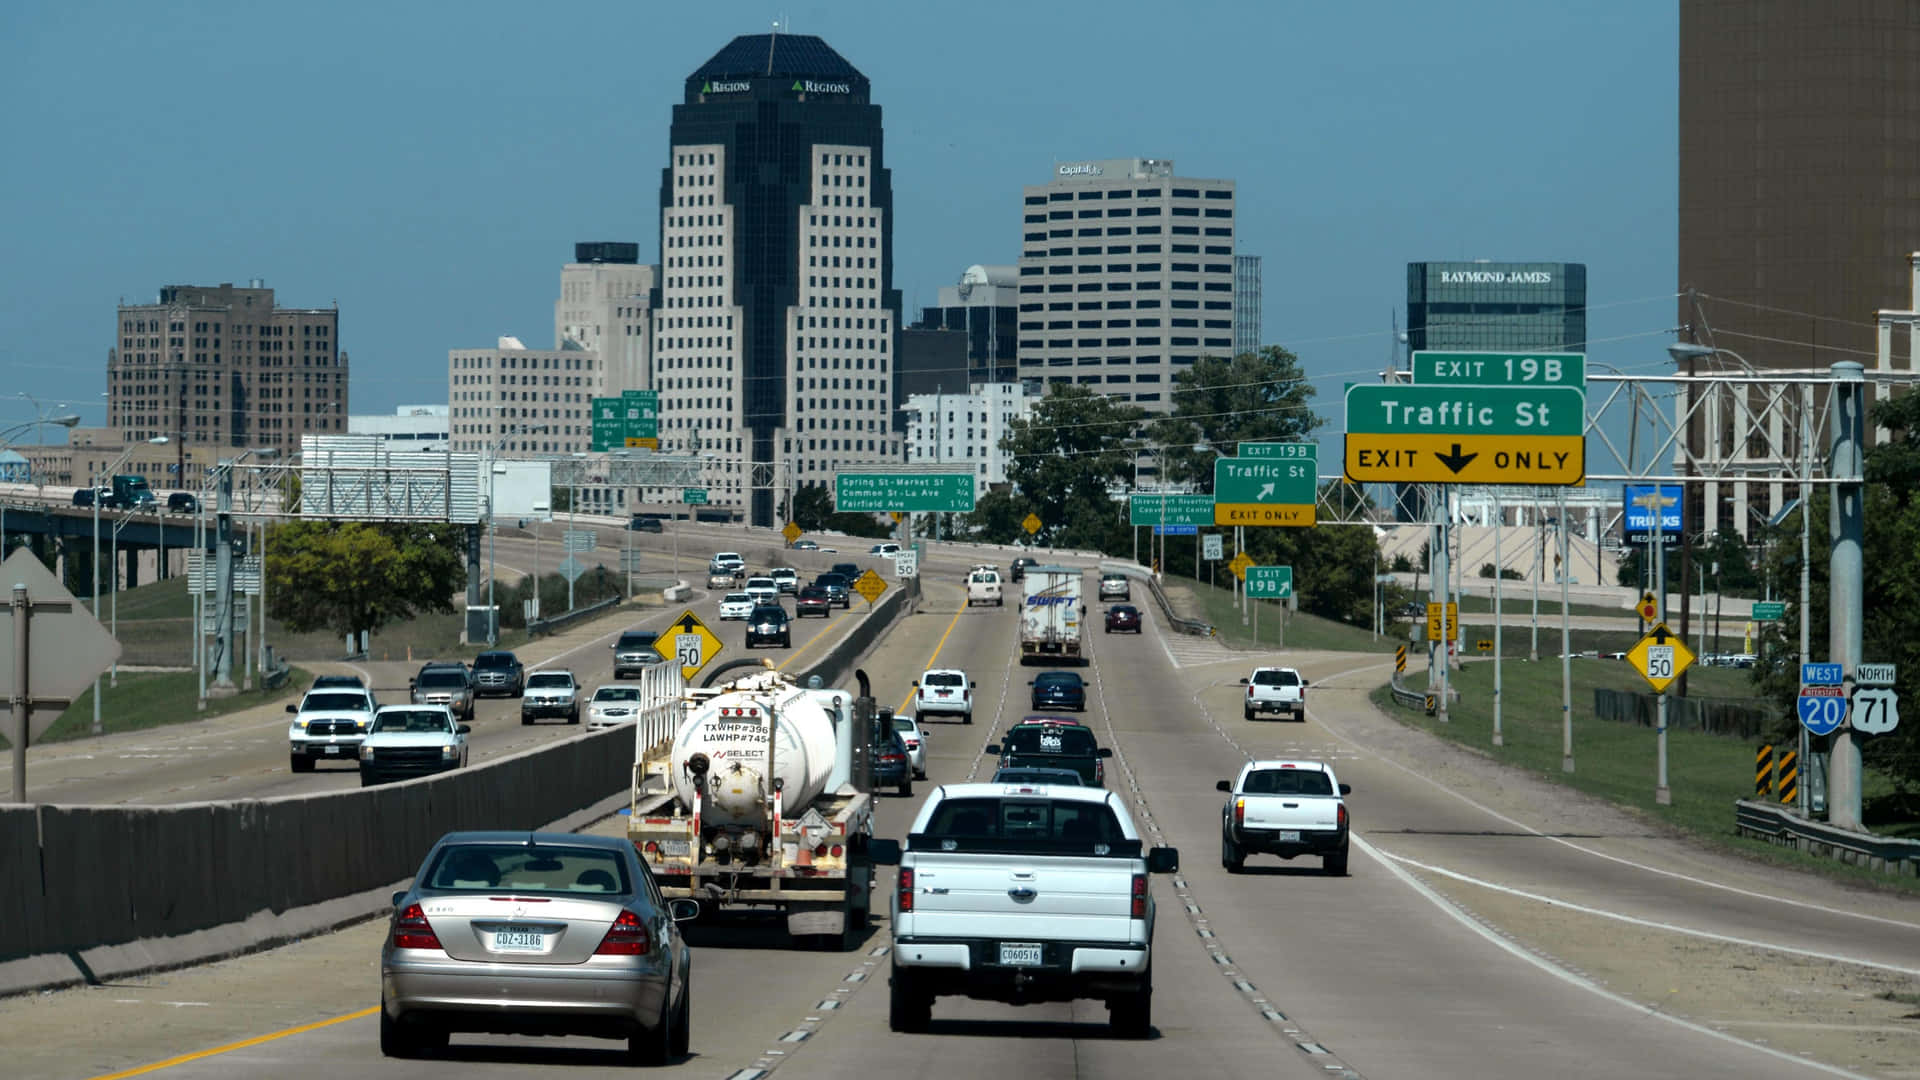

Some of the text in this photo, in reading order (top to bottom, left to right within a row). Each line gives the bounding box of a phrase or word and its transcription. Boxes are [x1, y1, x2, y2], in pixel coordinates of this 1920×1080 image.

[1441, 271, 1551, 283] RAYMOND JAMES
[1435, 358, 1563, 381] EXIT 19B
[1381, 400, 1550, 426] Traffic St
[1248, 446, 1307, 457] EXIT 19B
[1359, 449, 1569, 470] EXIT ONLY
[1227, 465, 1304, 477] Traffic St
[842, 478, 874, 487] Spring
[934, 478, 944, 486] St
[842, 489, 883, 497] Common
[921, 489, 939, 497] Ave
[842, 500, 882, 508] Fairfield
[888, 500, 904, 508] Ave
[1230, 511, 1299, 520] EXIT ONLY
[898, 566, 913, 575] 50
[1257, 570, 1280, 578] EXIT
[1249, 580, 1276, 591] 19B
[1026, 595, 1077, 607] SWIFT
[678, 648, 699, 666] 50
[1650, 659, 1671, 676] 50
[1806, 666, 1839, 681] WEST
[1857, 667, 1894, 680] NORTH
[1806, 698, 1839, 725] 20
[1860, 697, 1888, 724] 71
